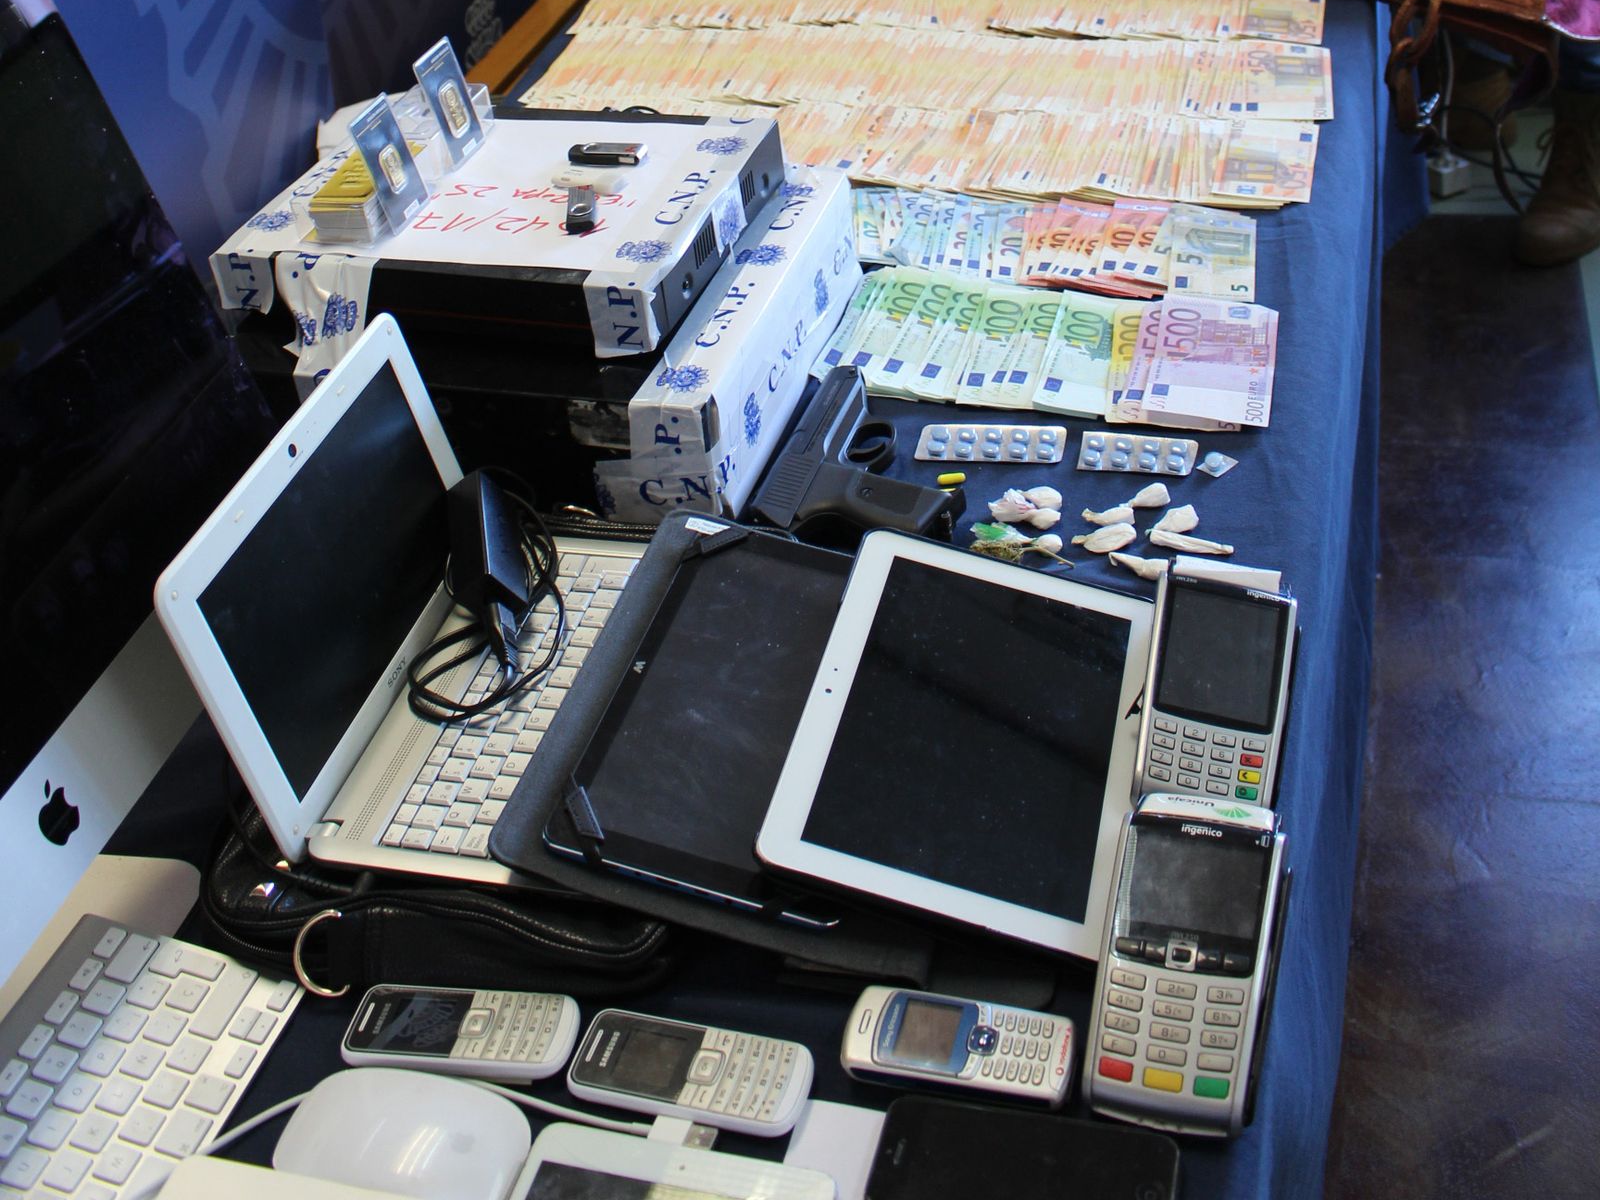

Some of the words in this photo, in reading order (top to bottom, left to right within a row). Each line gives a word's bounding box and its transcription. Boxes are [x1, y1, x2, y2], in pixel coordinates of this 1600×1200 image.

[655, 169, 716, 226] C.N.P.
[1110, 231, 1135, 249] 10
[1177, 253, 1203, 265] 5
[1231, 284, 1249, 293] 5
[696, 282, 755, 348] C.N.P.
[983, 300, 1023, 335] 100
[1063, 310, 1105, 343] 100
[1163, 308, 1201, 349] 500
[1247, 381, 1258, 400] EURO
[1245, 402, 1264, 424] 500
[386, 655, 409, 688] SONY
[1181, 823, 1223, 838] ingenico
[599, 1031, 621, 1068] SAMSUNG
